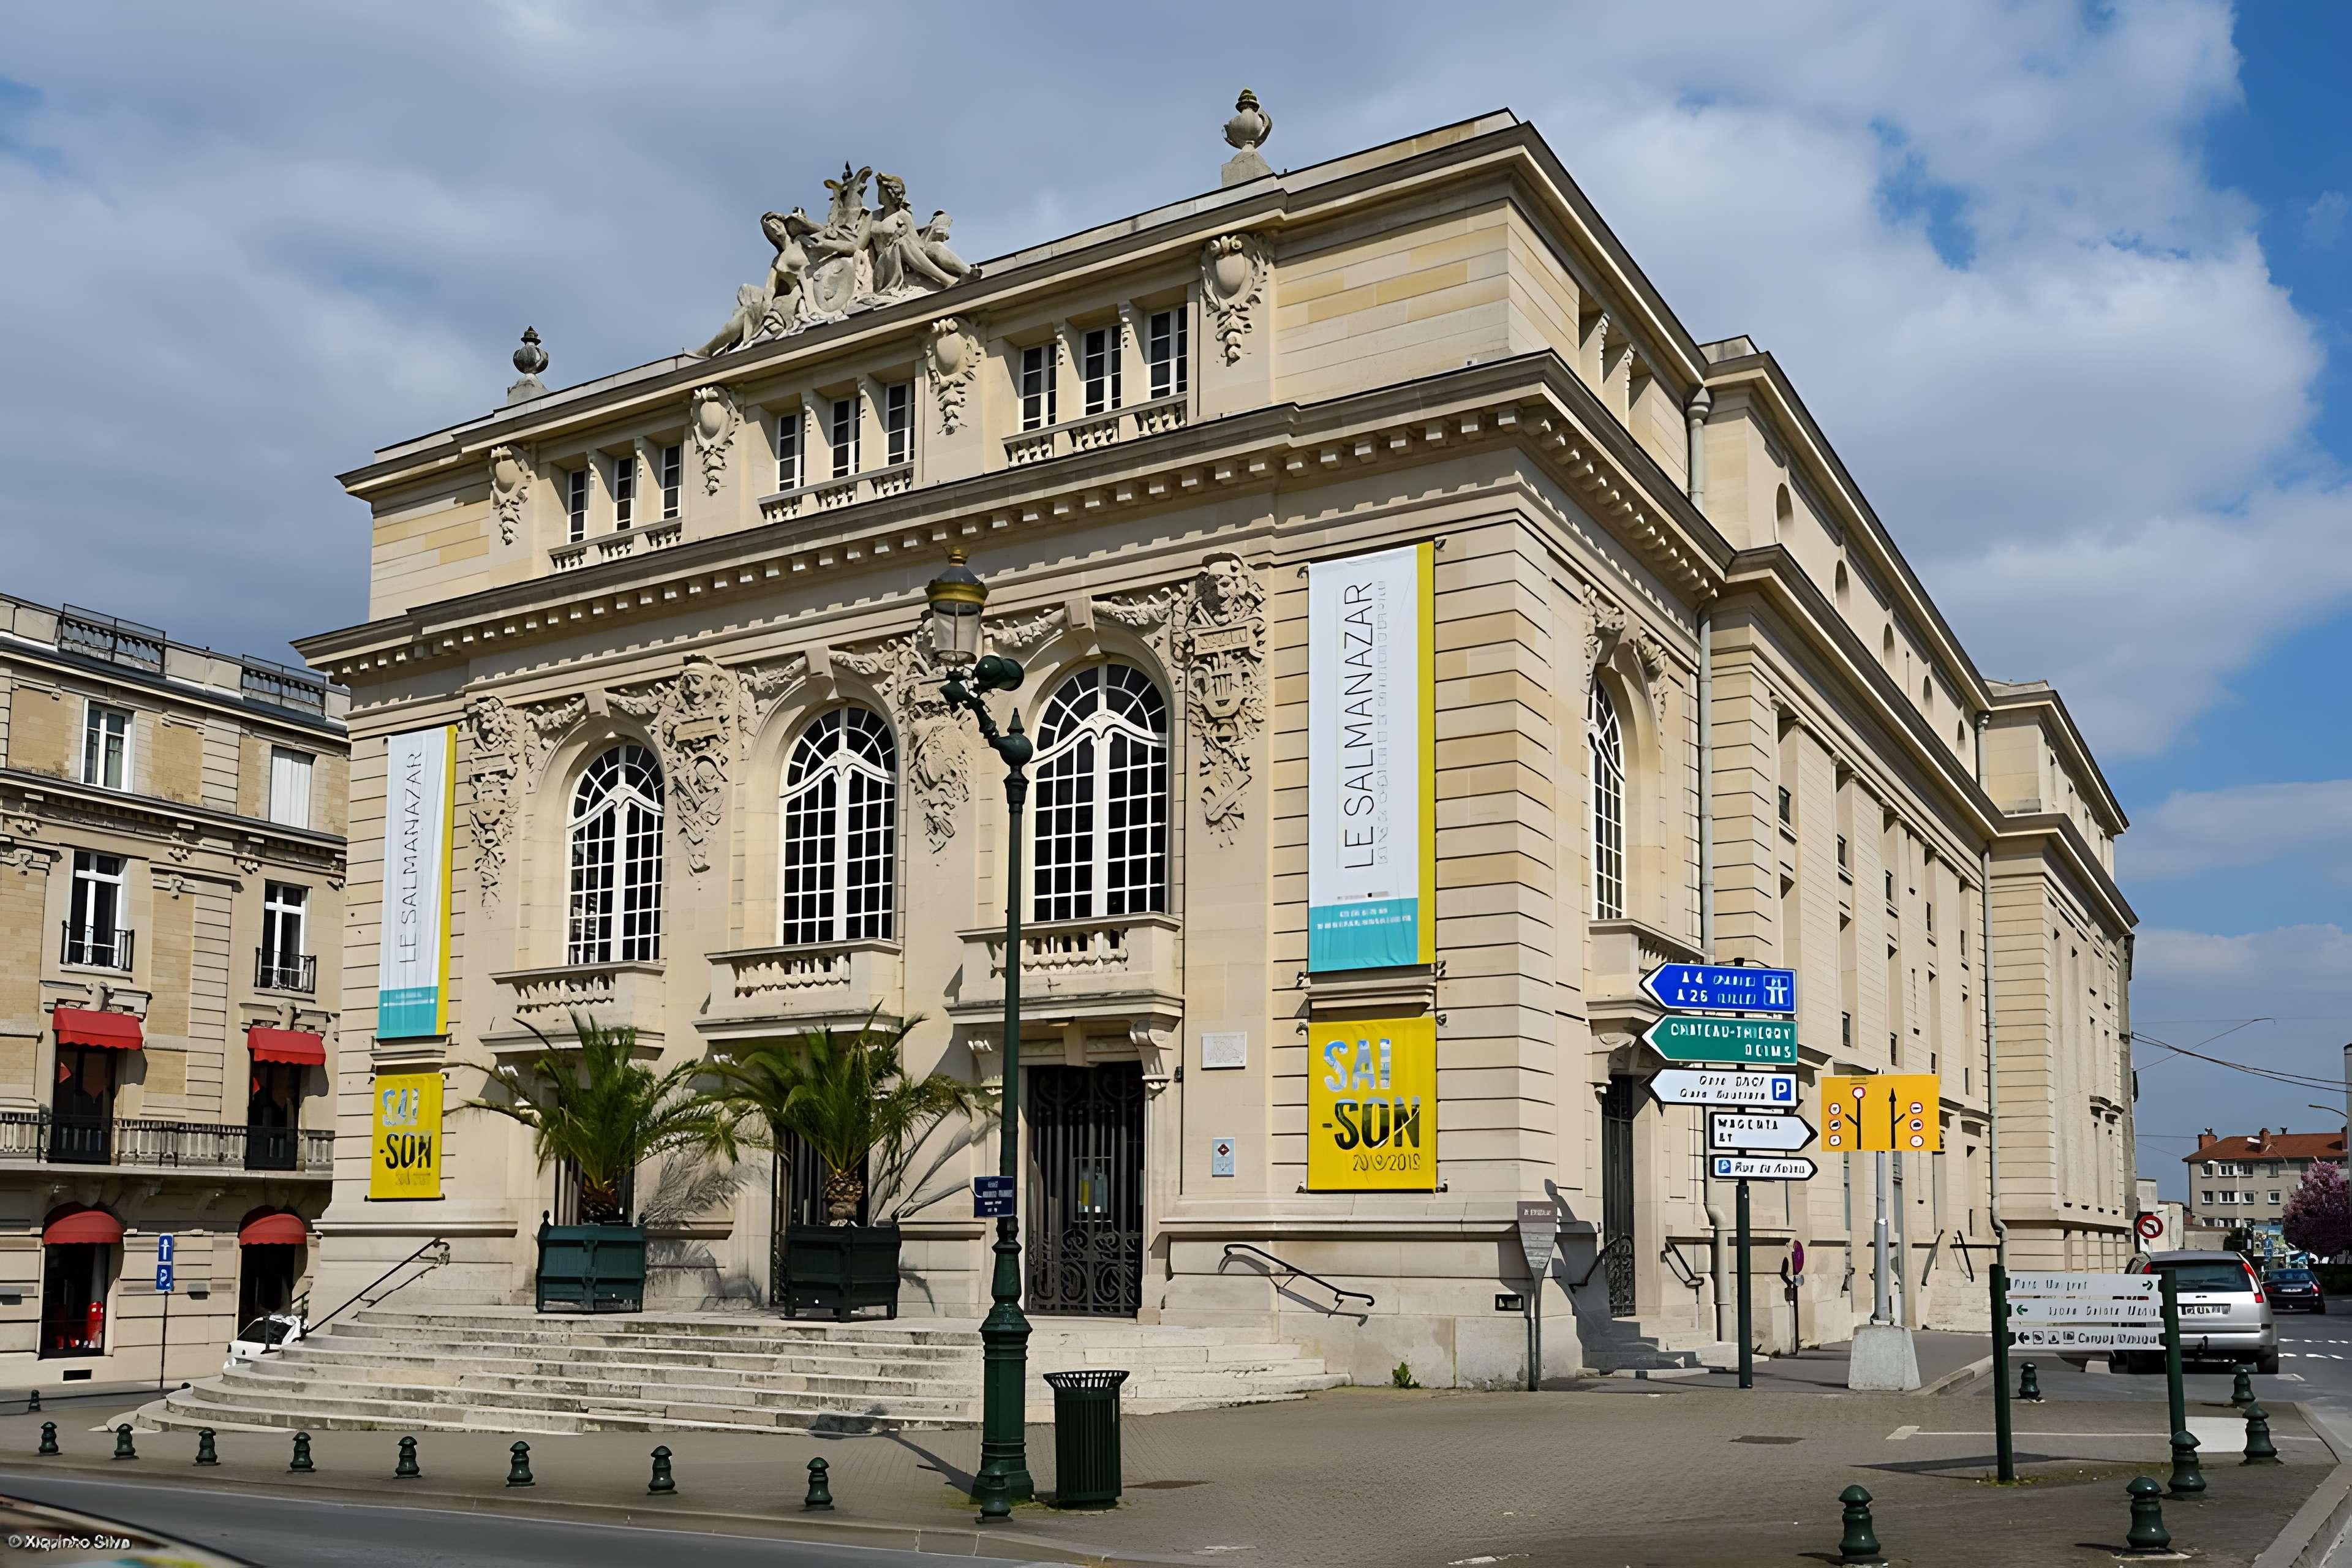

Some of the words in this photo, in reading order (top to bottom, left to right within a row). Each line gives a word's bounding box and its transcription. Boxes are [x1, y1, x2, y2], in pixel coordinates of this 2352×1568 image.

[1344, 582, 1374, 816] SALMANAZAR
[401, 752, 422, 925] SALMANAZAR
[1344, 826, 1374, 869] LE
[398, 932, 417, 963] LE
[1324, 1039, 1392, 1092] SAI
[1776, 1082, 1787, 1098] P
